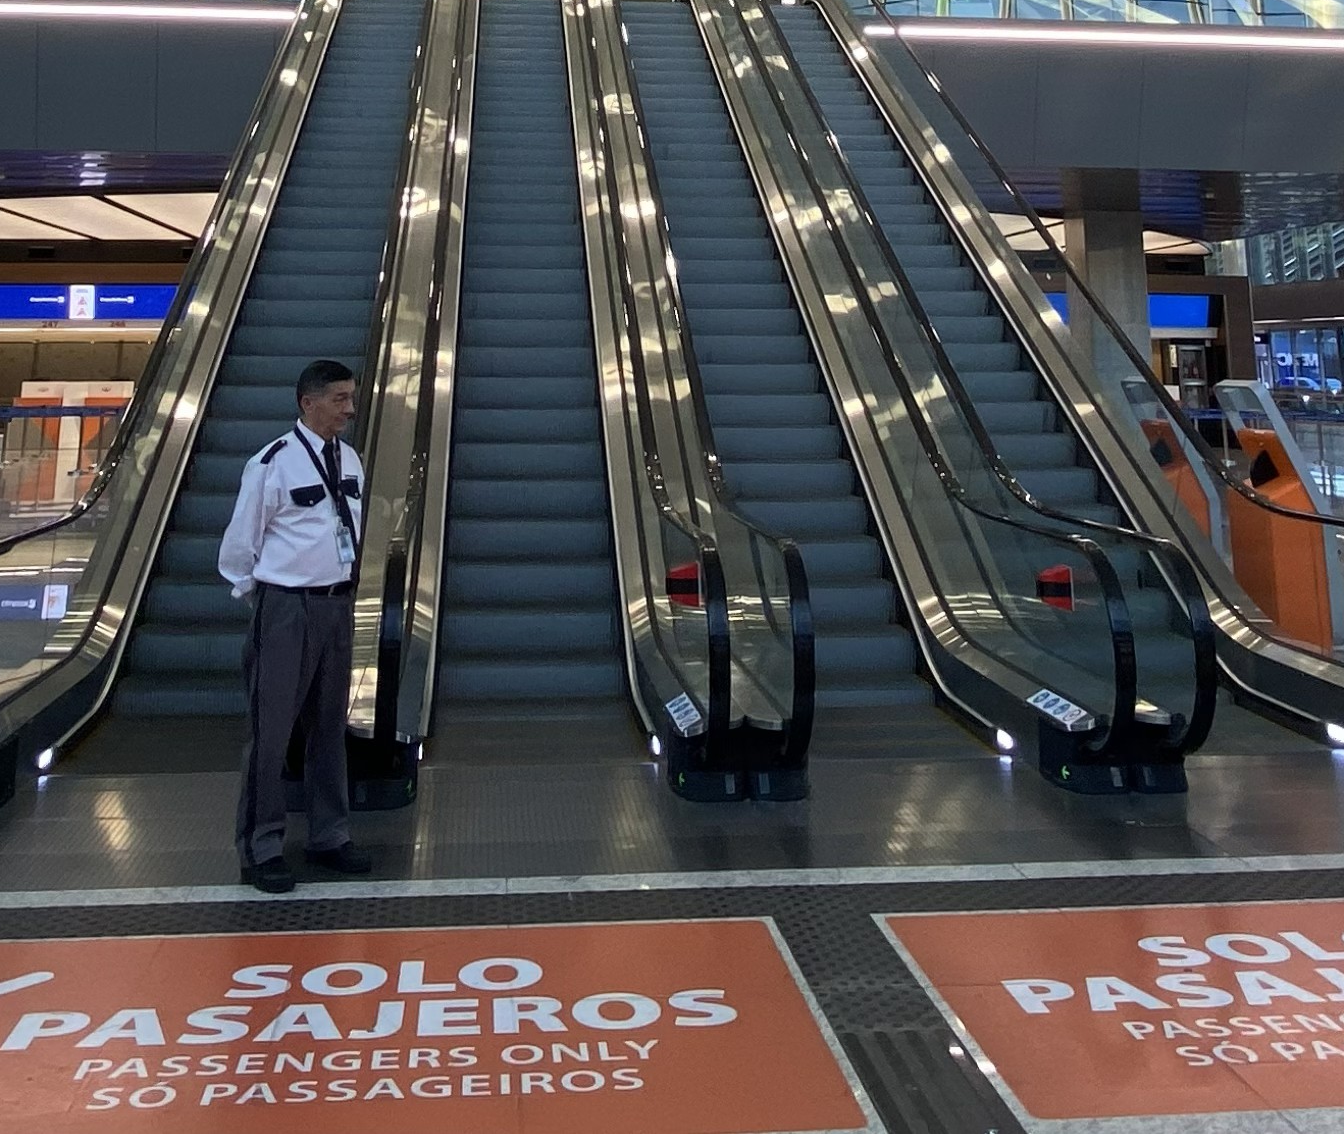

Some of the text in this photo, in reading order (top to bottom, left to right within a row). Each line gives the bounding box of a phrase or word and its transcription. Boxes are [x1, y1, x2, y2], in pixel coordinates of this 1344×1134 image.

[224, 957, 544, 999] SOLO
[0, 988, 738, 1051] PASAJEROS
[72, 1039, 659, 1081] PASSENGERS ONLY
[1175, 1040, 1259, 1066] SÓ
[84, 1068, 645, 1110] SÓ PASSAGEIROS
